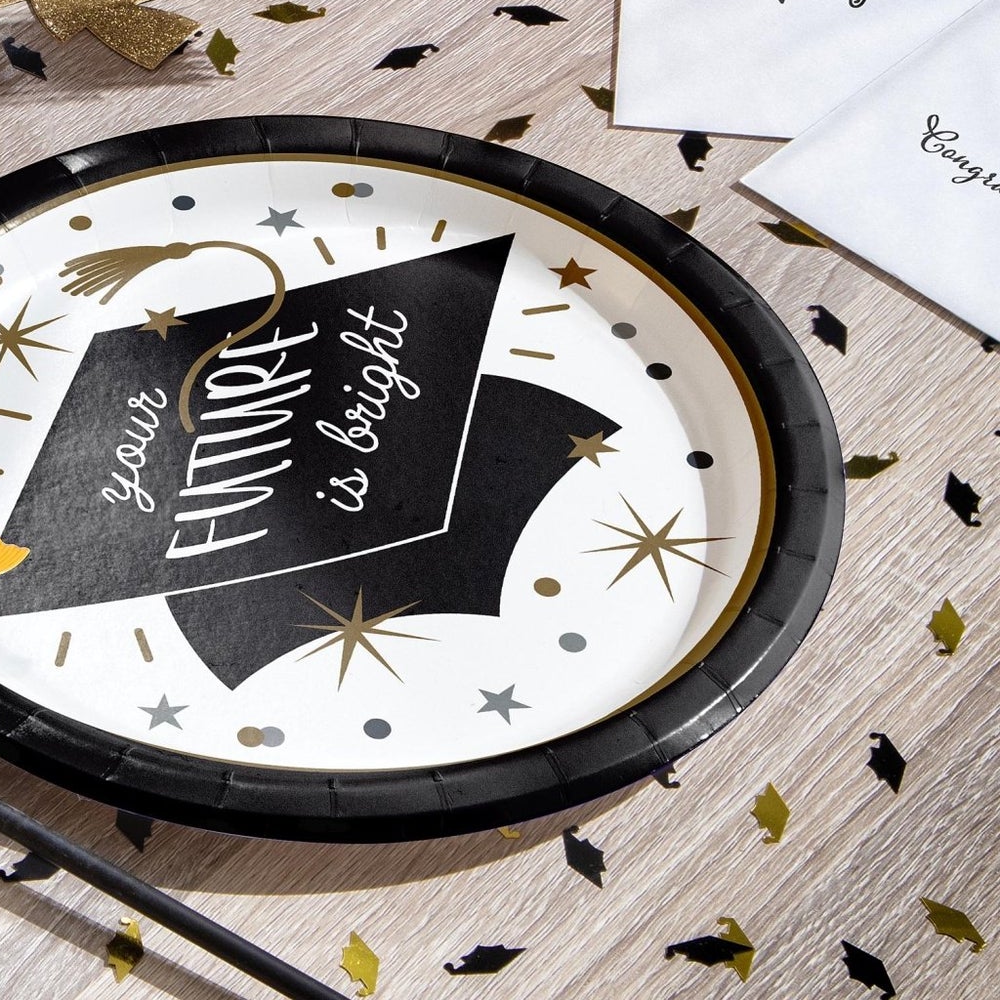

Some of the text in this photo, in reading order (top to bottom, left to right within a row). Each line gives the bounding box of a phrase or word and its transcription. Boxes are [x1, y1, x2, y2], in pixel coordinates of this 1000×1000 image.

[101, 387, 168, 513] your
[165, 321, 319, 560] FUTURE
[316, 305, 421, 513] is bright
